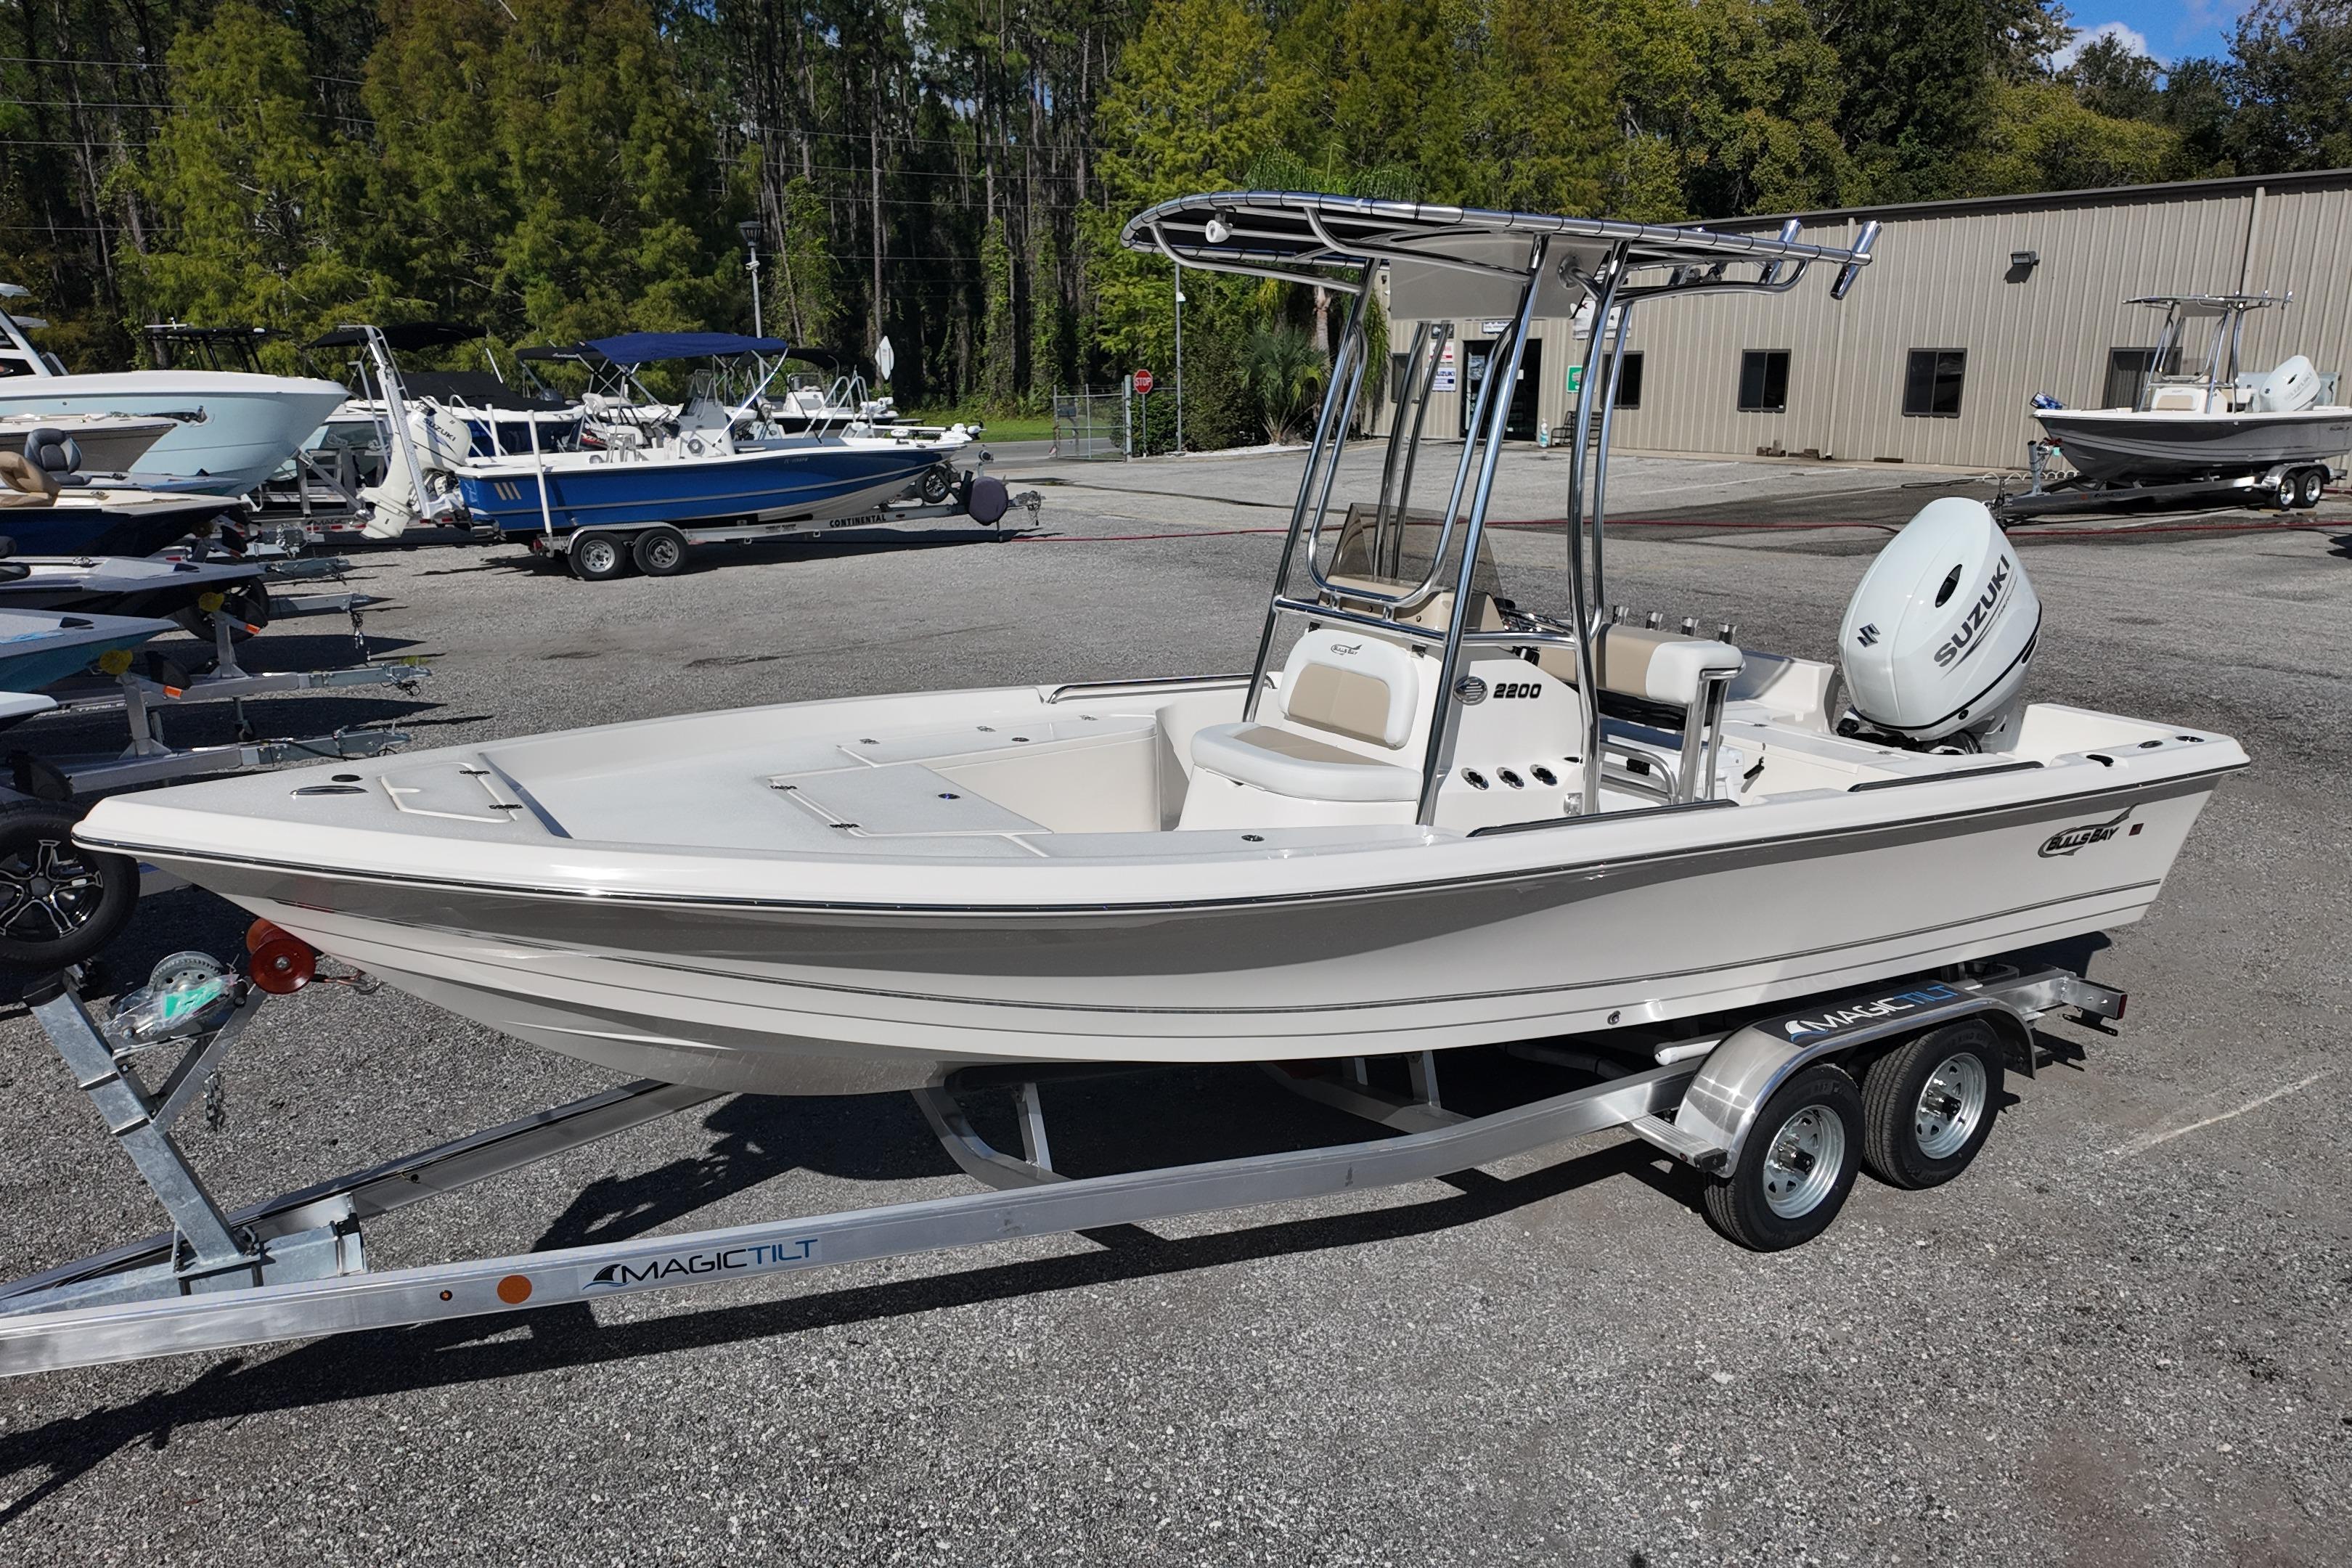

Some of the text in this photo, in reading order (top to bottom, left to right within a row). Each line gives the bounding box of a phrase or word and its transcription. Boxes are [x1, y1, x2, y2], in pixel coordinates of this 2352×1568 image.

[1135, 377, 1151, 387] STOP
[423, 417, 457, 442] SUZUKI
[829, 514, 887, 528] CONTINENTAL
[1933, 553, 2010, 668] SUZUKI
[1493, 683, 1542, 698] 2200
[1801, 984, 1959, 1032] MAGICTILT
[621, 1238, 818, 1283] MAGICTILT
